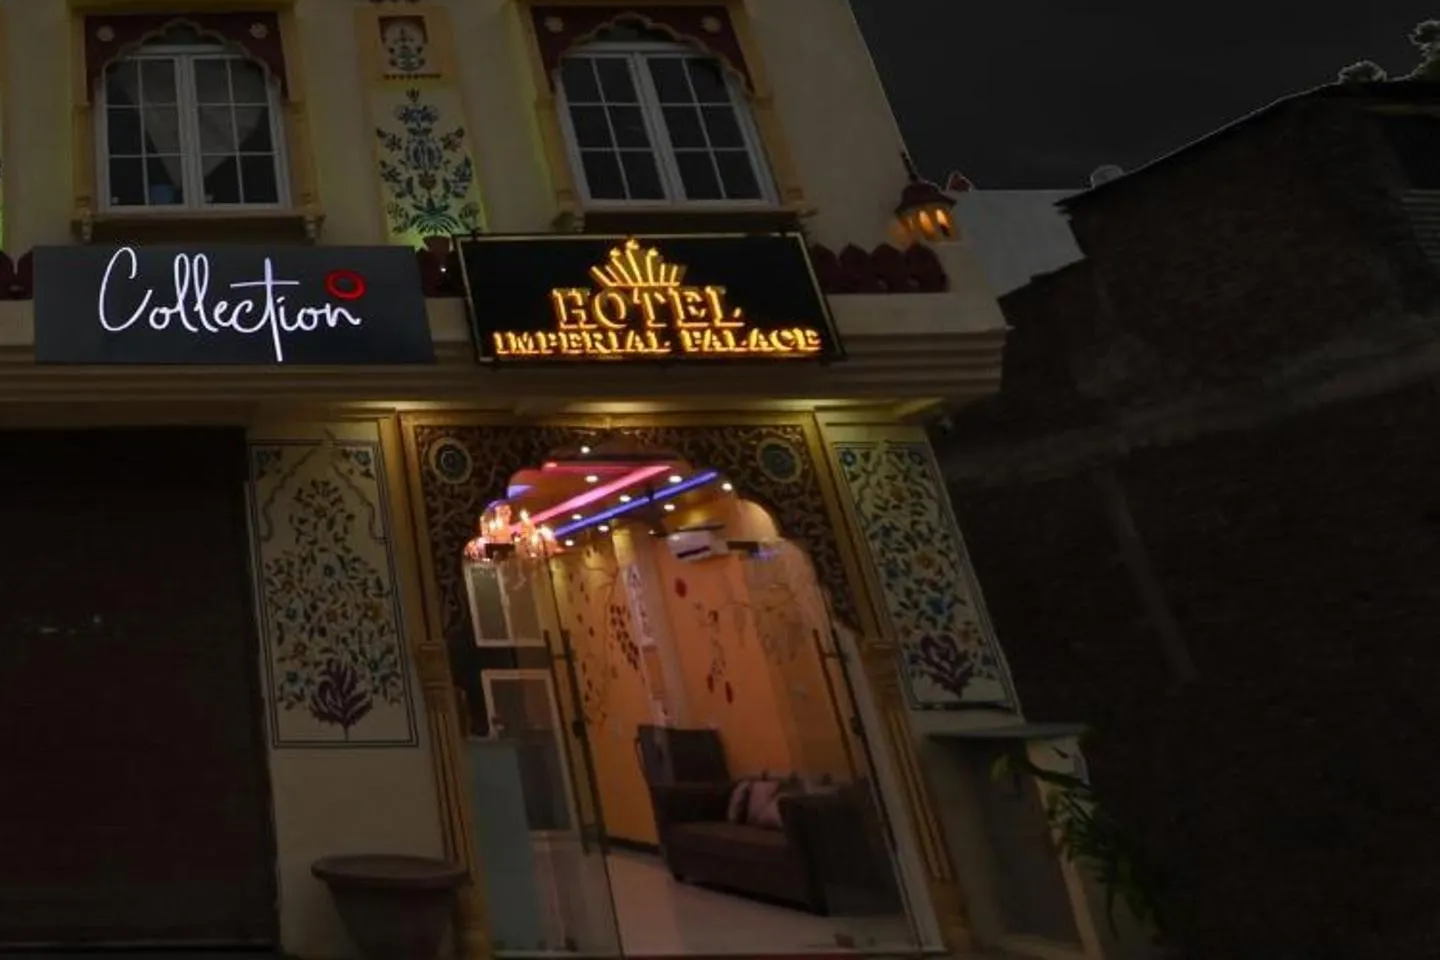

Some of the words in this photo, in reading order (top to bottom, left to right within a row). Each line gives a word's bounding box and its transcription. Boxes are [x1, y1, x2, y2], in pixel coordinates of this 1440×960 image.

[99, 247, 362, 362] Collection
[550, 285, 746, 330] HOTEL
[492, 329, 672, 356] IMPERIAL
[678, 327, 824, 354] PALACE
